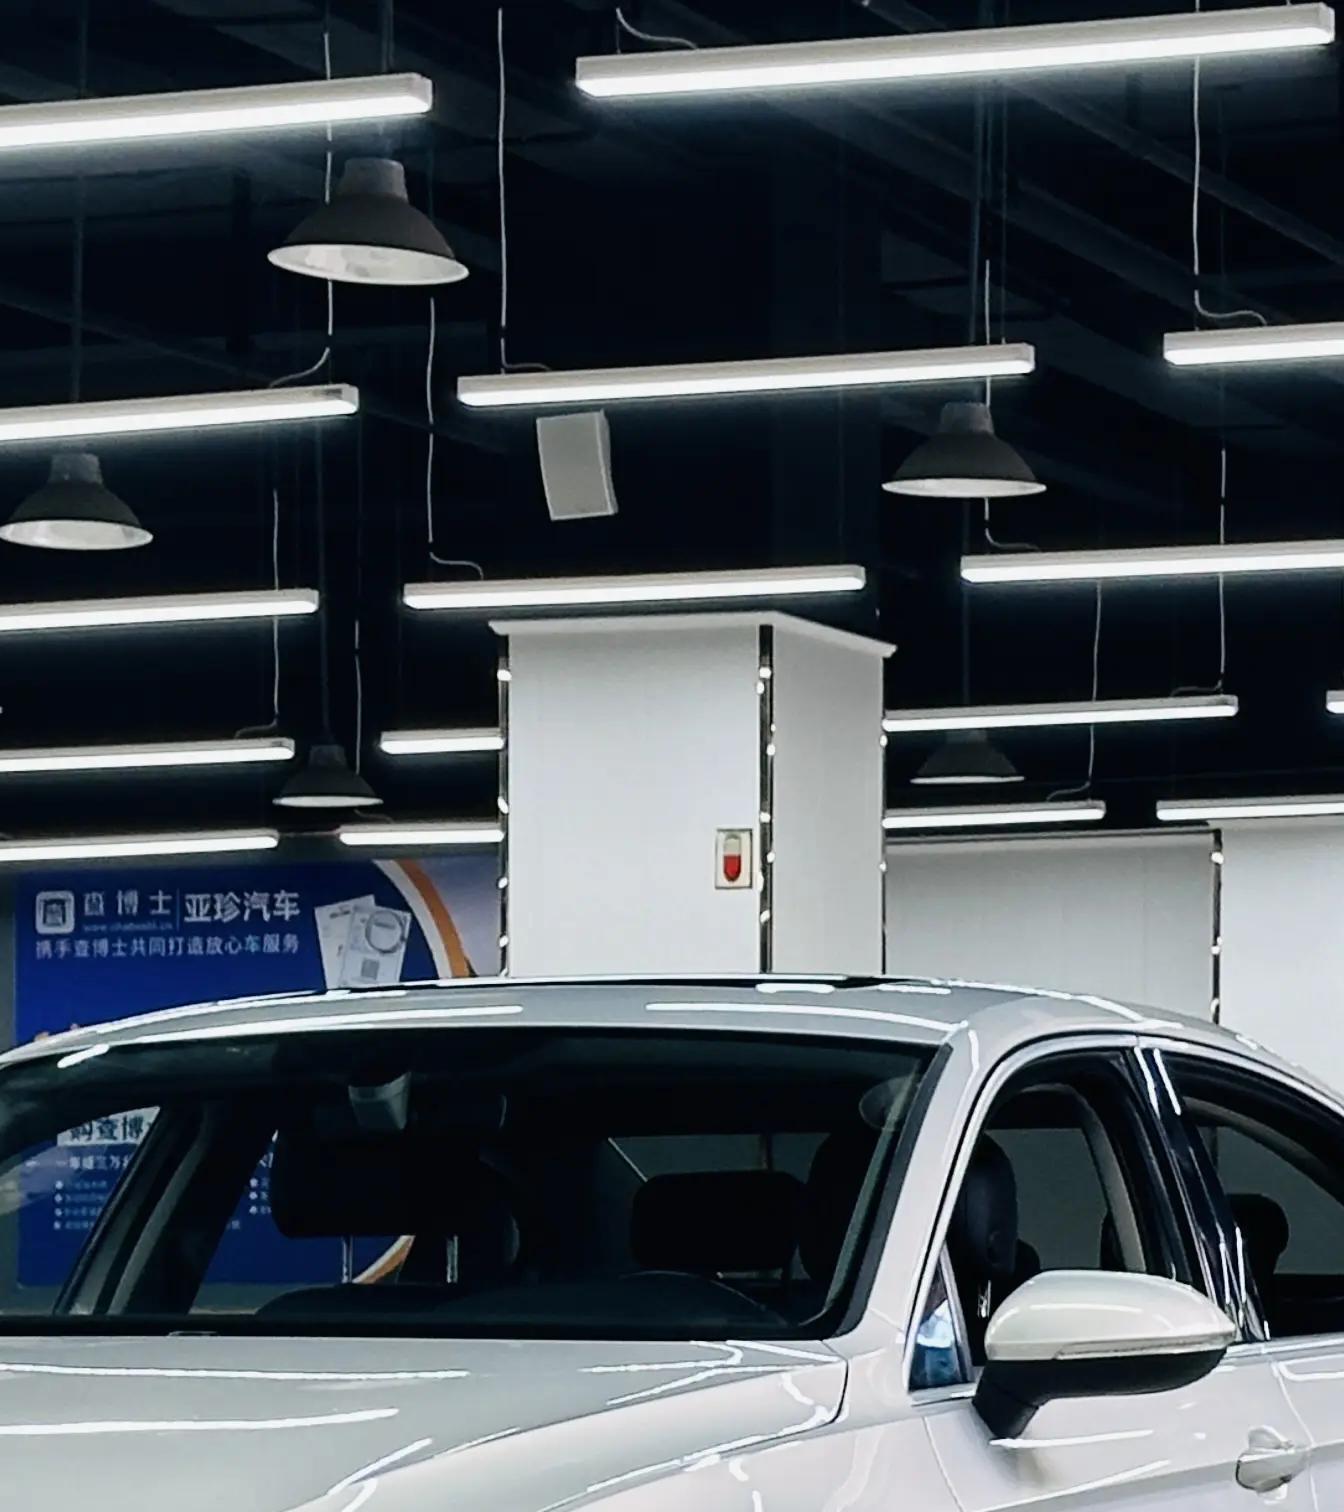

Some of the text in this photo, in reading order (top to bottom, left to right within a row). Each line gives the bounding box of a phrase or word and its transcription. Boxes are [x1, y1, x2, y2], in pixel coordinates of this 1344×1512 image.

[183, 889, 301, 923] 亚珍汽车
[35, 933, 299, 961] 携手查博士共同打造放心车服务
